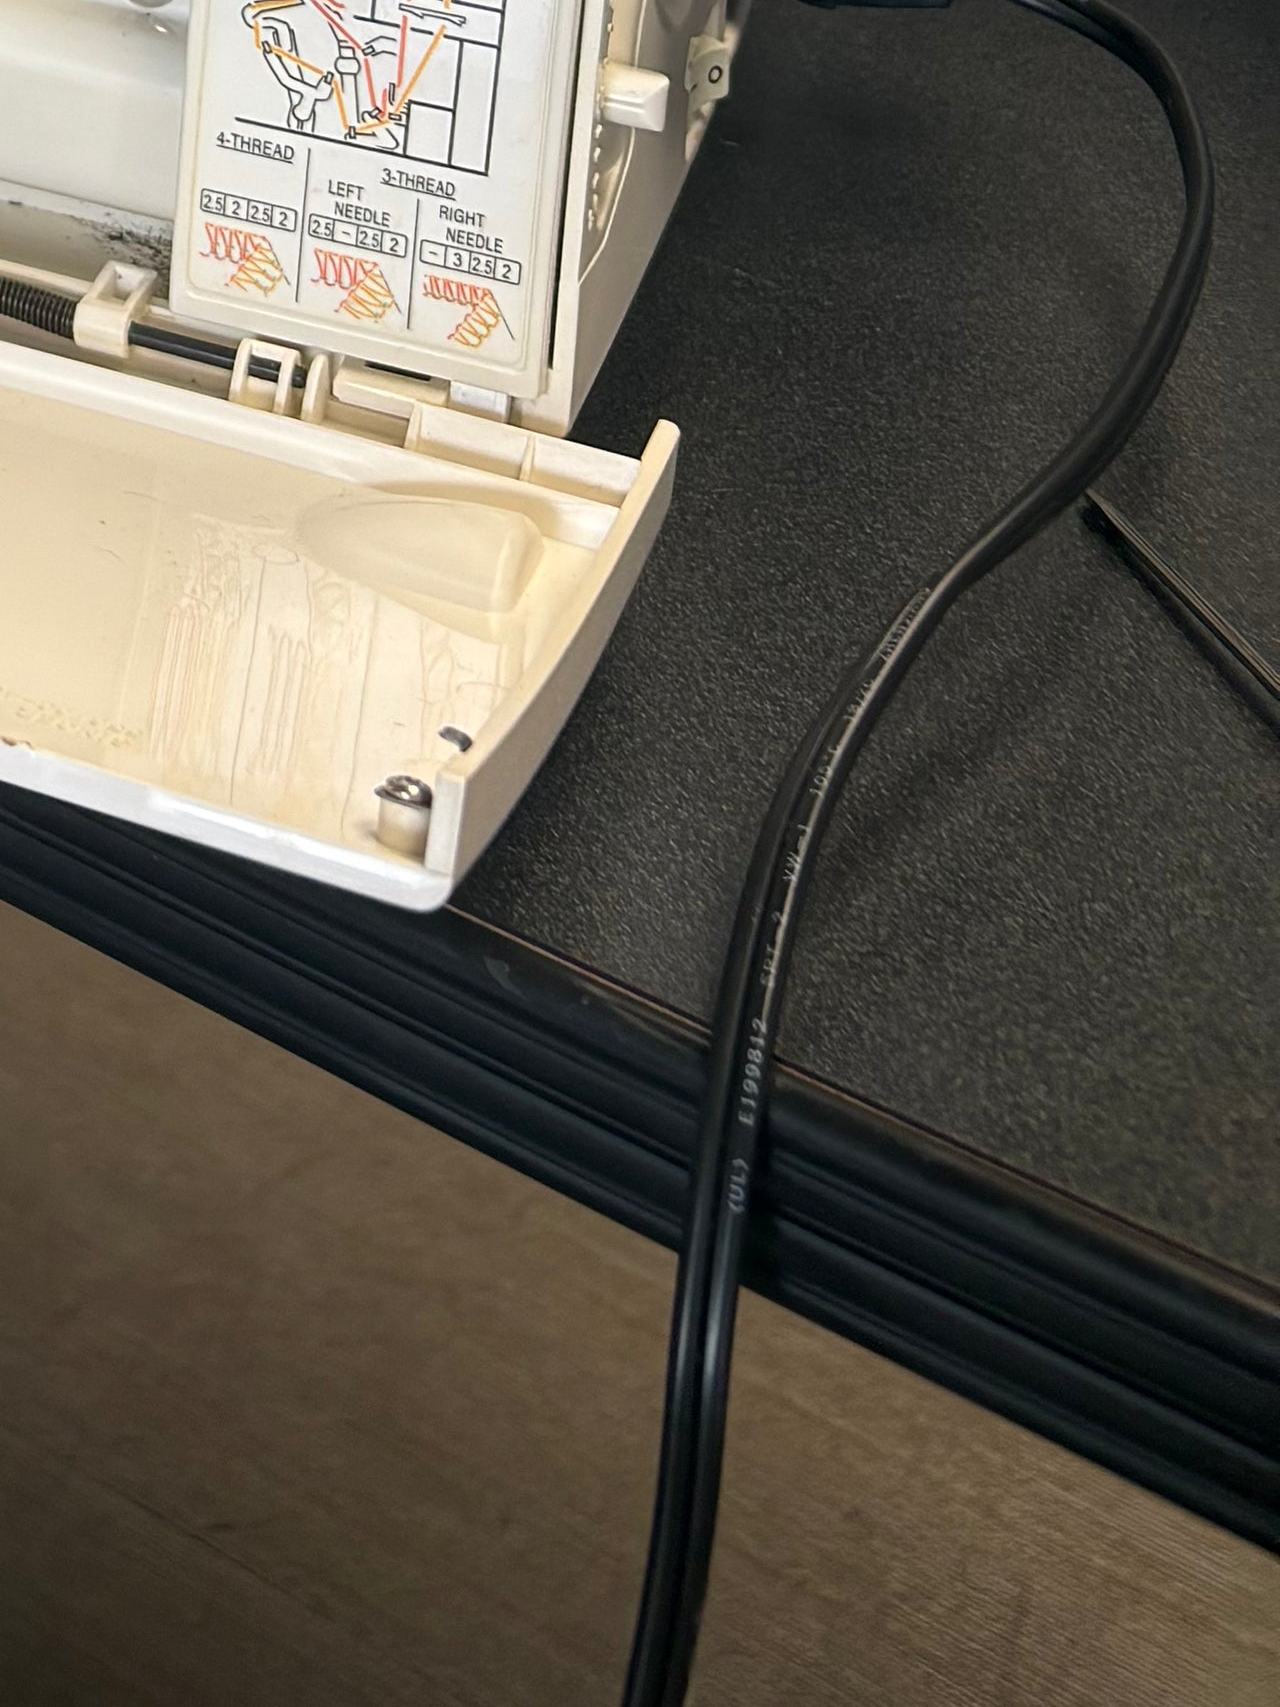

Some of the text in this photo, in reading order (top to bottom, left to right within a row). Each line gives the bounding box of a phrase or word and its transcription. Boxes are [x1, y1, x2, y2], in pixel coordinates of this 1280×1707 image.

[216, 131, 295, 161] 4-THREAD
[328, 179, 365, 200] LEFT
[381, 168, 456, 197] 3-THREAD
[203, 194, 288, 227] 2.5 2 2.5 2
[334, 201, 391, 227] NEEDLE
[439, 205, 487, 228] RIGHT
[312, 220, 333, 236] 2.5
[359, 230, 380, 248] 2.5
[389, 237, 399, 253] 2
[446, 227, 503, 254] NEEDLE
[453, 252, 462, 267] 3
[472, 257, 492, 274] 2.5
[502, 264, 512, 280] 2
